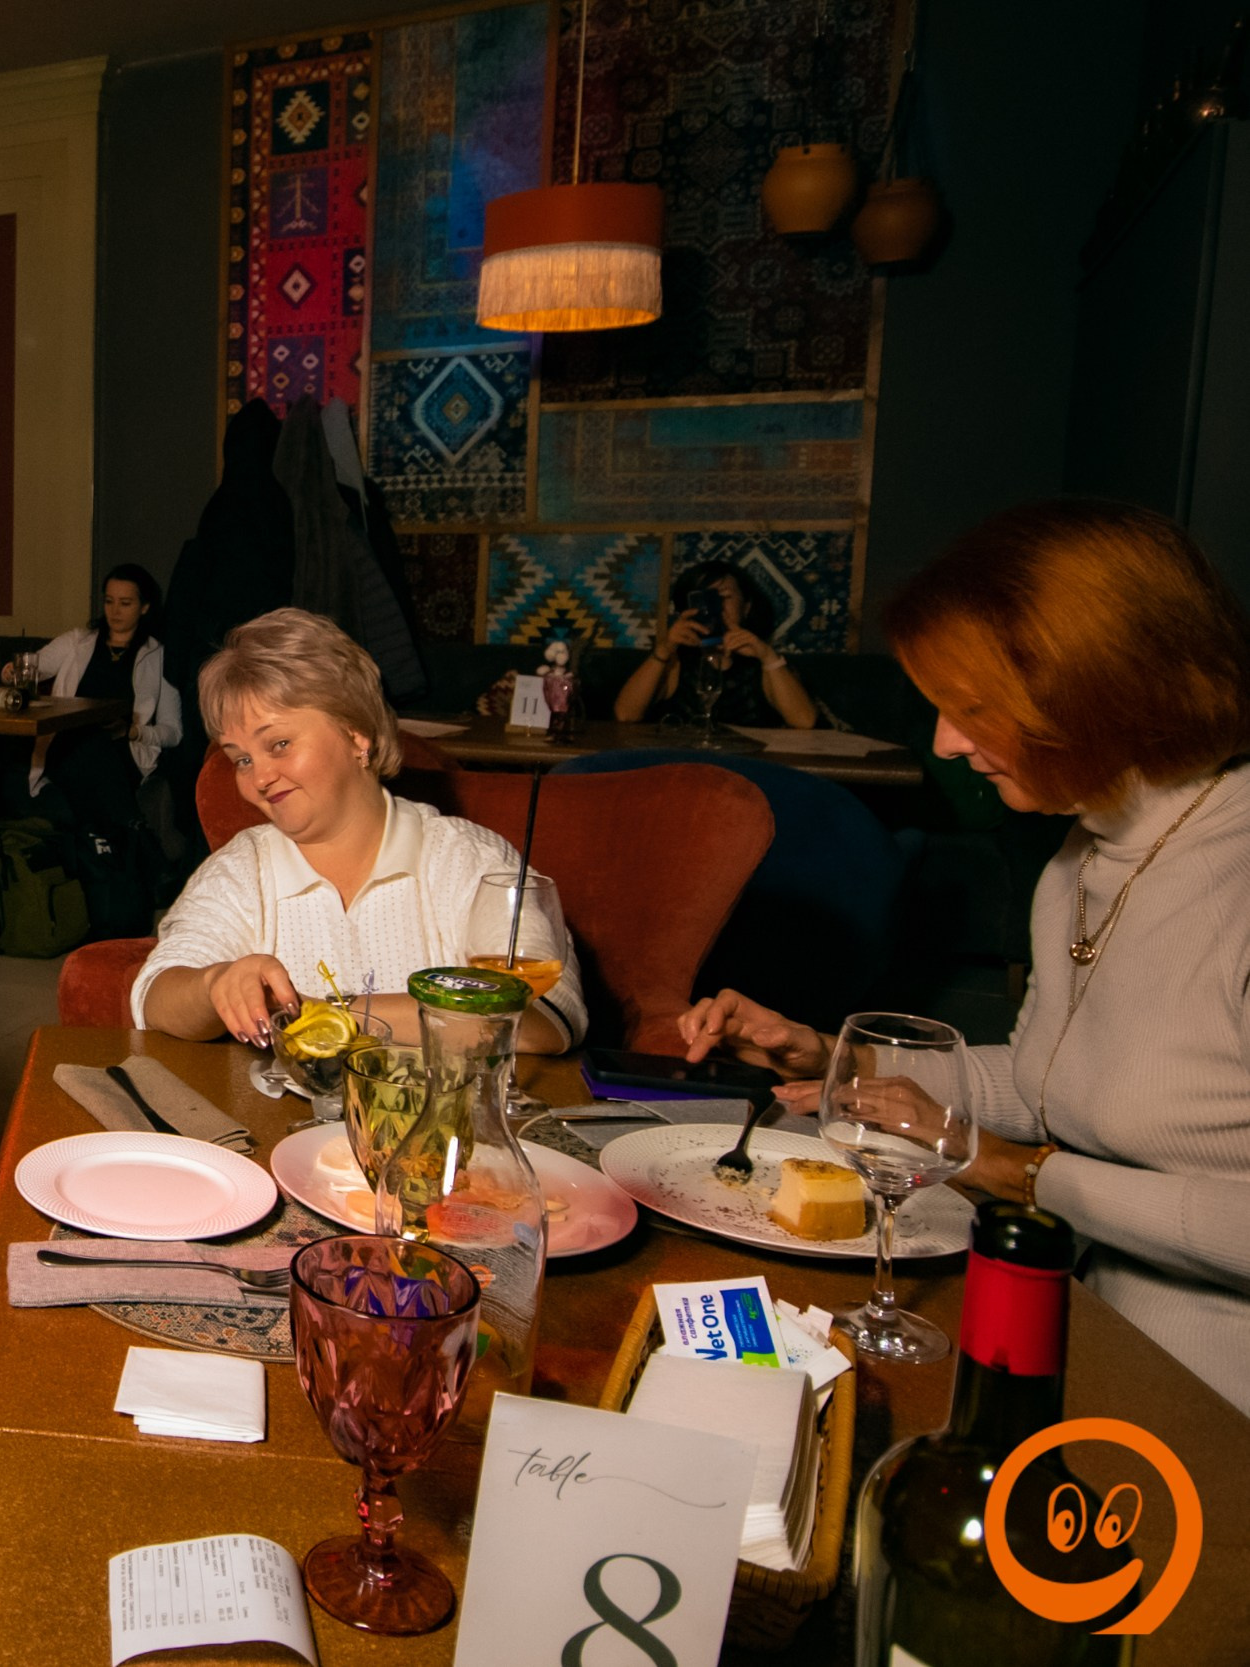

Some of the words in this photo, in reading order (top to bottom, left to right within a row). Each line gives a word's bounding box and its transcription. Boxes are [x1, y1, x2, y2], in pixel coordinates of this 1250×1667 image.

[522, 697, 538, 715] 11
[675, 1308, 689, 1346] влажная
[700, 1294, 720, 1328] One
[561, 1553, 682, 1667] 8
